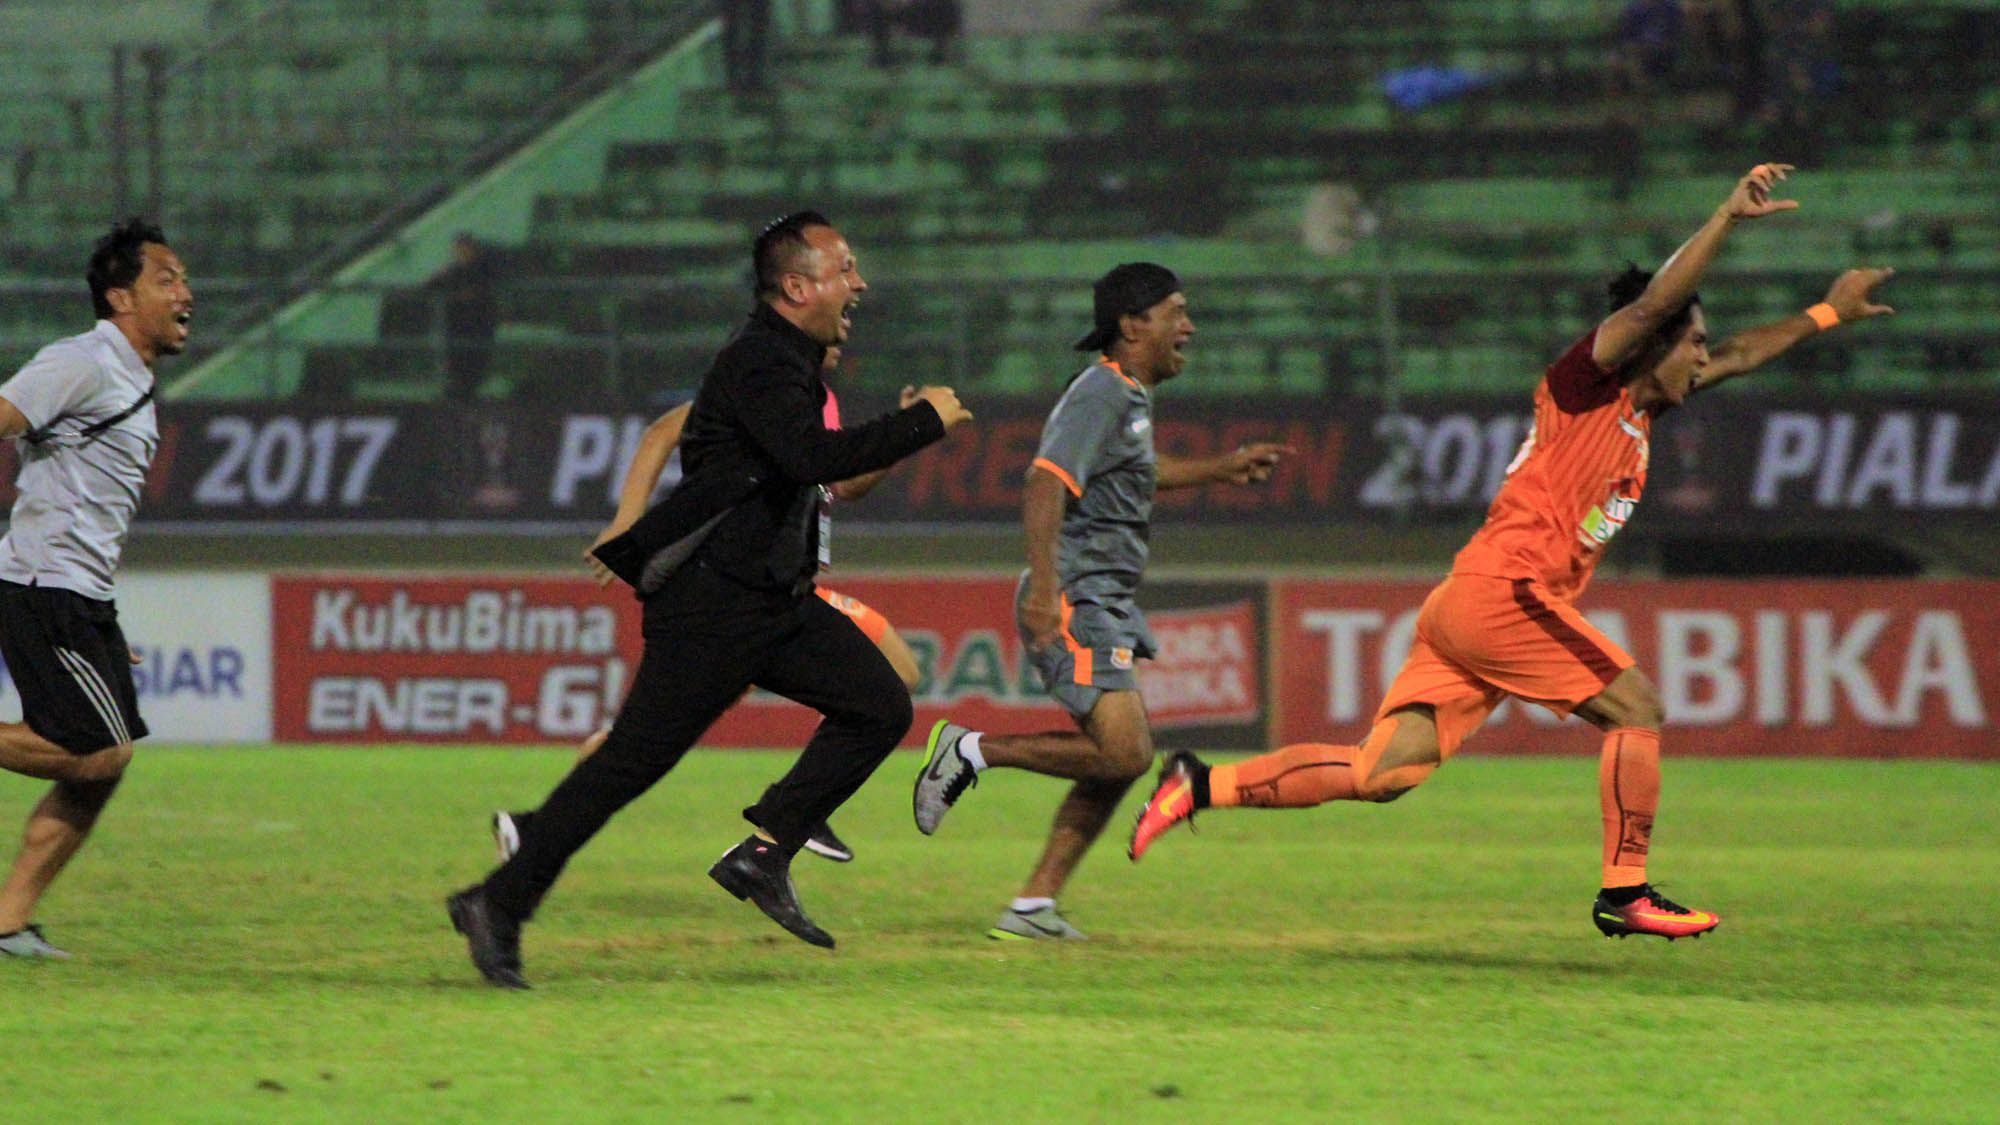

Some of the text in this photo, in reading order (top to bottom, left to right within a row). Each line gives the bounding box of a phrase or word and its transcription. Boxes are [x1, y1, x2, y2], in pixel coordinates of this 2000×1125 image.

[192, 414, 397, 506] 2017
[1361, 413, 1538, 507] 201
[1753, 411, 2000, 507] PIAL
[311, 590, 615, 654] KukuBima
